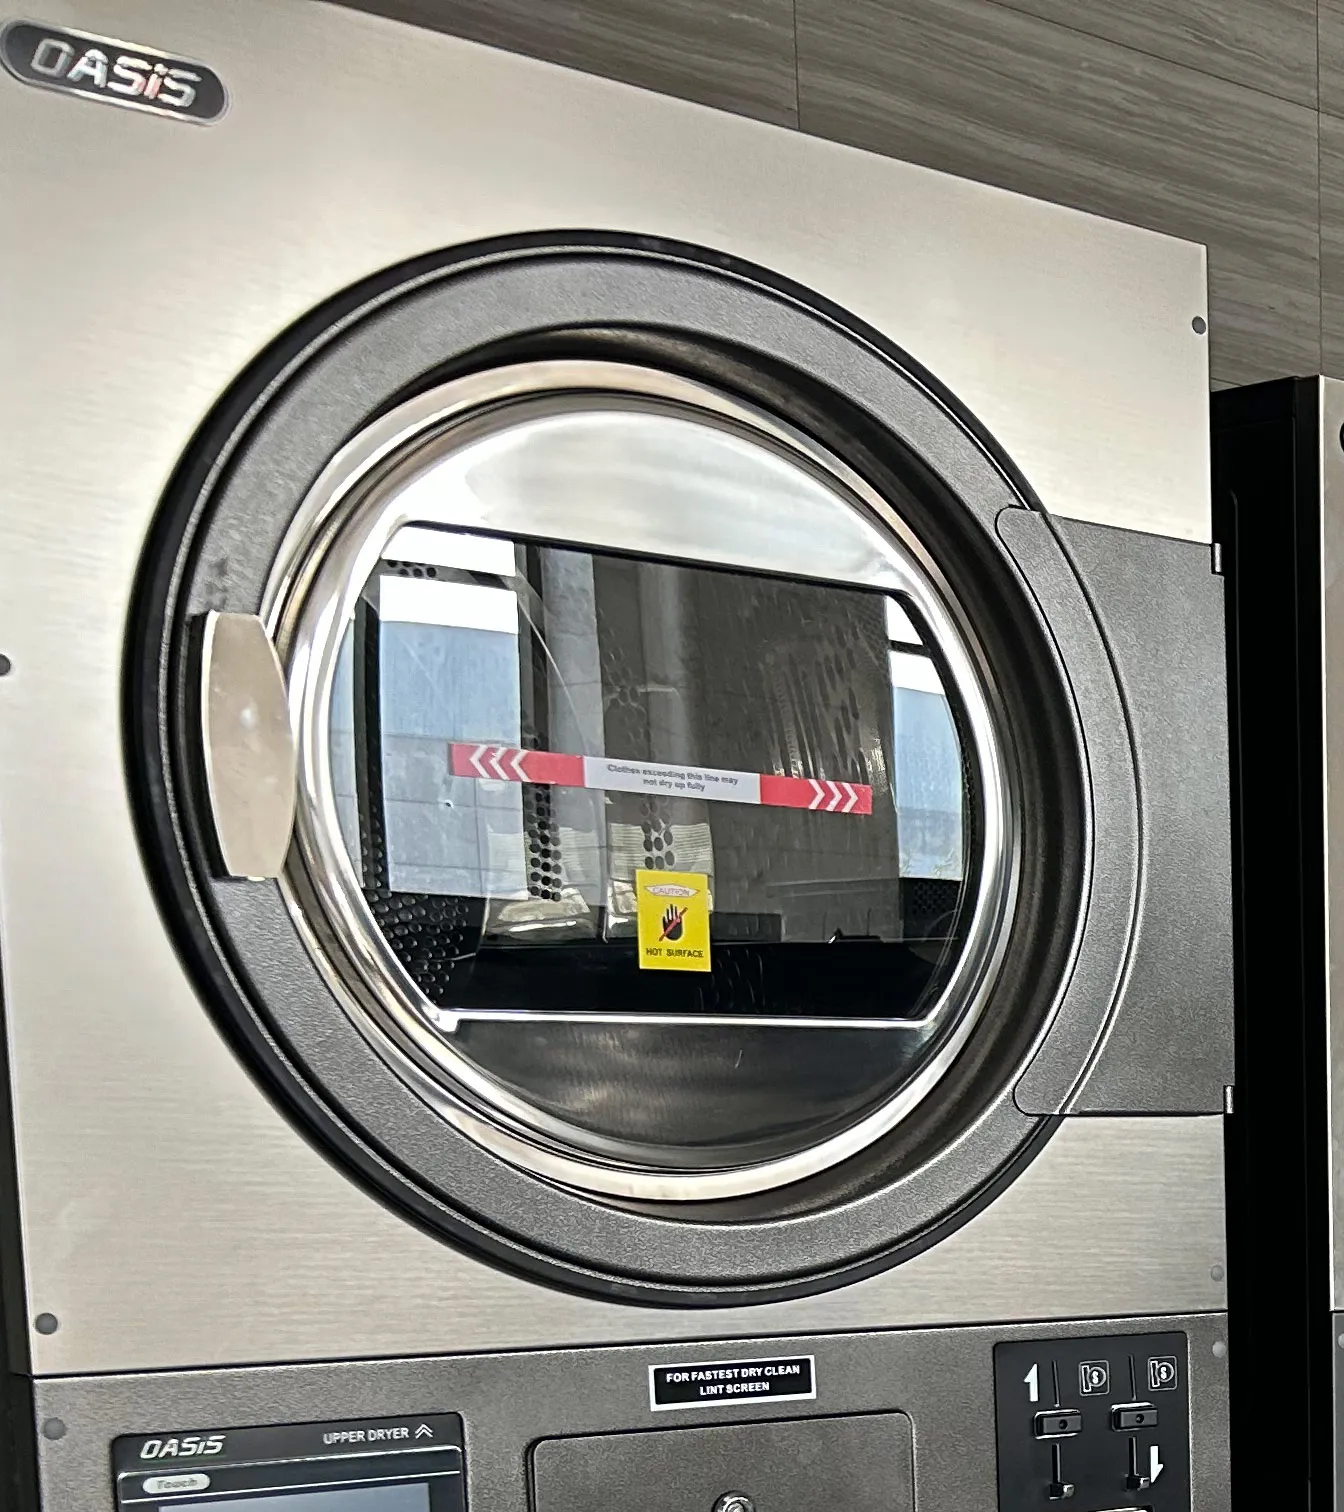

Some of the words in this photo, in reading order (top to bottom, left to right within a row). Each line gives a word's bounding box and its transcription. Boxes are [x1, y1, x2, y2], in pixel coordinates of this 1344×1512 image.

[608, 764, 640, 774] Clothes
[643, 769, 685, 780] exceeding
[687, 772, 702, 780] this
[705, 773, 719, 782] line
[643, 778, 657, 786] not
[659, 779, 672, 788] dry
[687, 782, 705, 792] fully
[645, 948, 662, 956] HOT
[667, 949, 704, 958] SURFACE
[666, 1372, 690, 1383] FOR
[691, 1369, 739, 1381] FASTEST
[741, 1367, 762, 1378] DRY
[764, 1365, 800, 1376] CLEAN
[699, 1385, 723, 1396] LINT
[726, 1382, 769, 1394] SCREEN
[323, 1430, 365, 1445] UPPER
[367, 1427, 410, 1441] DRYER
